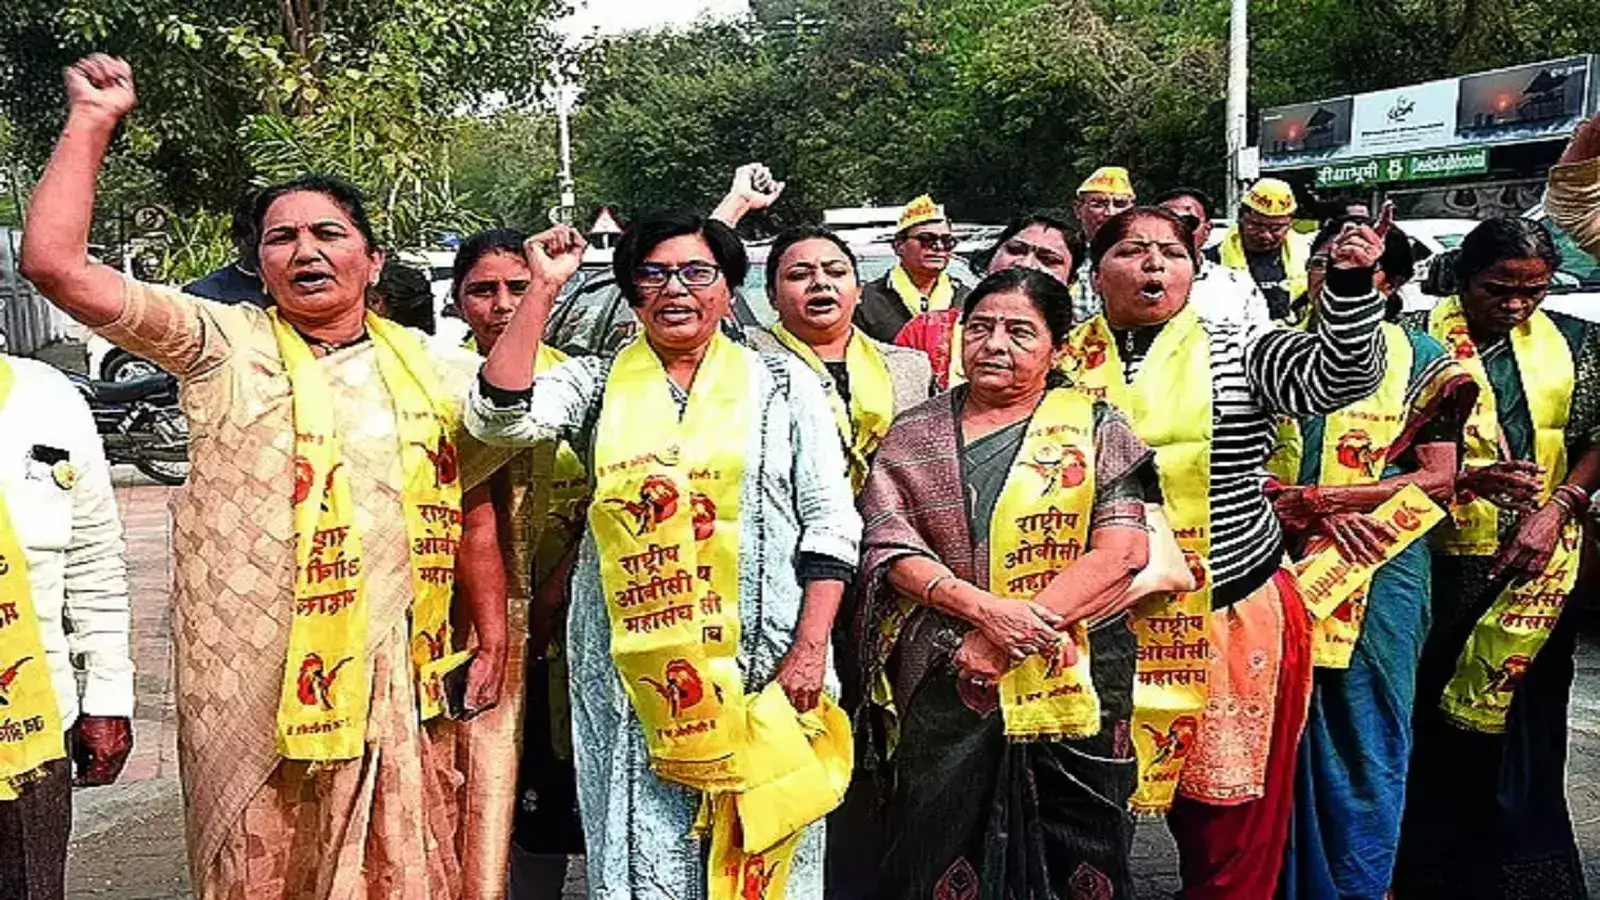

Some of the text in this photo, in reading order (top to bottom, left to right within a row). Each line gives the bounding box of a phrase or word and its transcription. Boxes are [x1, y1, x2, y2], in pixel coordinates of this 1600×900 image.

[1014, 505, 1081, 537] राष्ट्रीय
[619, 543, 681, 577] राष्ट्रीय
[1004, 538, 1081, 569] ओबीसी
[615, 569, 693, 608] ओबीसी
[623, 600, 695, 635] महासंघ
[1148, 612, 1204, 639] राष्ट्रीय
[1137, 637, 1210, 661] ओबीसी
[1138, 664, 1206, 686] महासंघ
